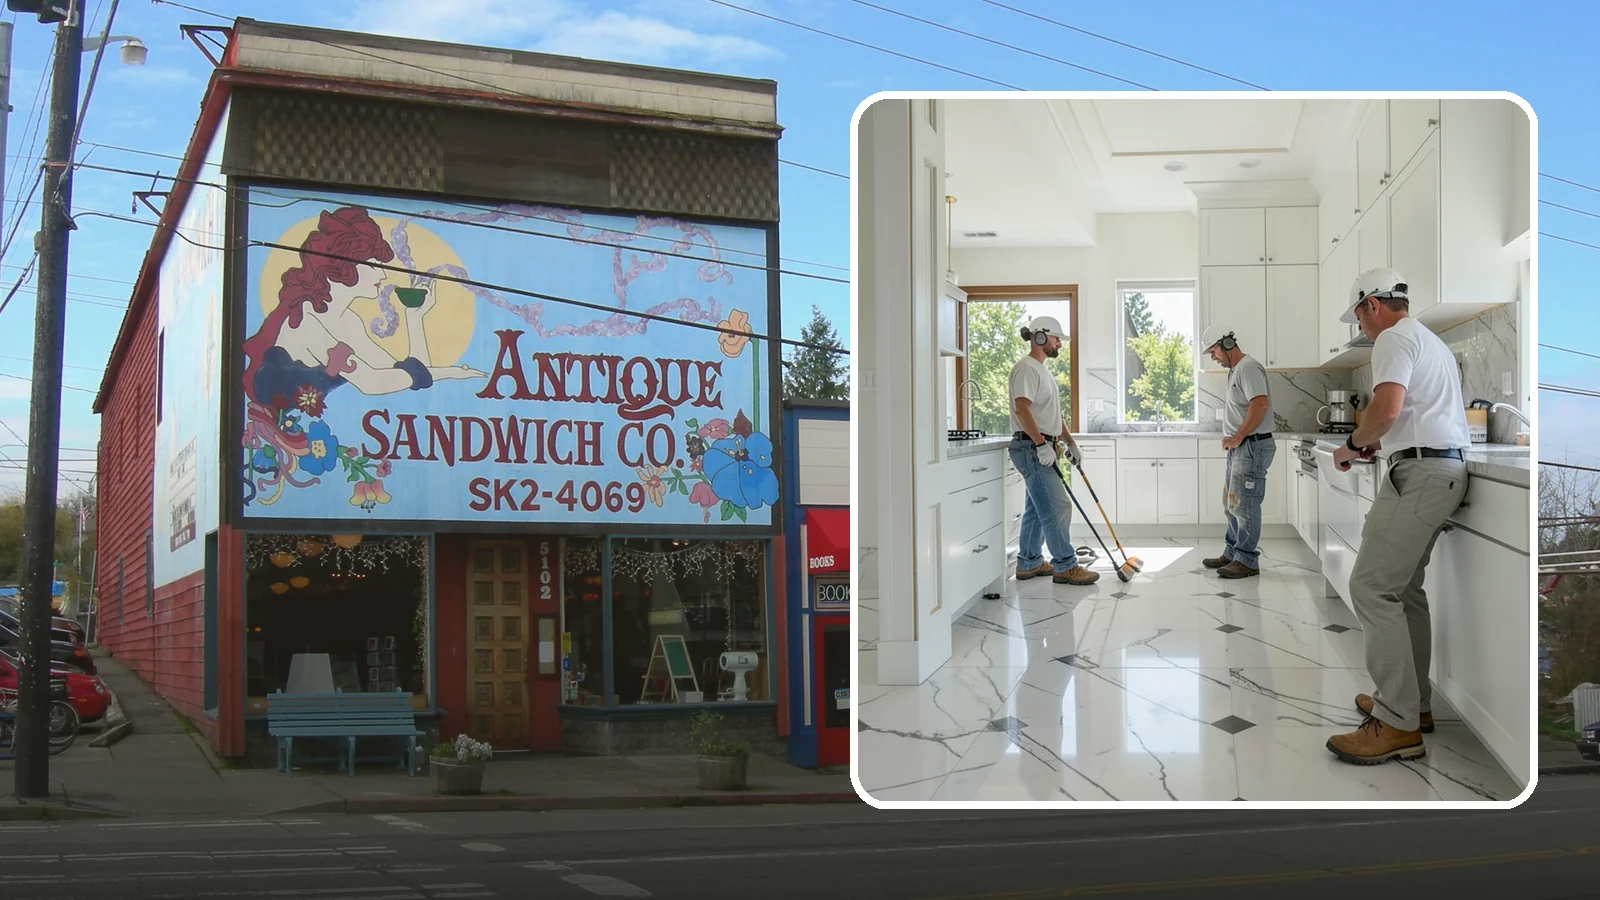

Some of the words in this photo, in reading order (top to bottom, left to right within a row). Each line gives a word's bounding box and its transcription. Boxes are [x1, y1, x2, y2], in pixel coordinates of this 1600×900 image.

[476, 329, 723, 421] ANTIQUE
[361, 409, 604, 467] SANDWICH
[617, 422, 686, 469] CO.
[468, 477, 645, 513] SK2-4069
[539, 542, 552, 599] 5102
[809, 555, 835, 569] BOOKS
